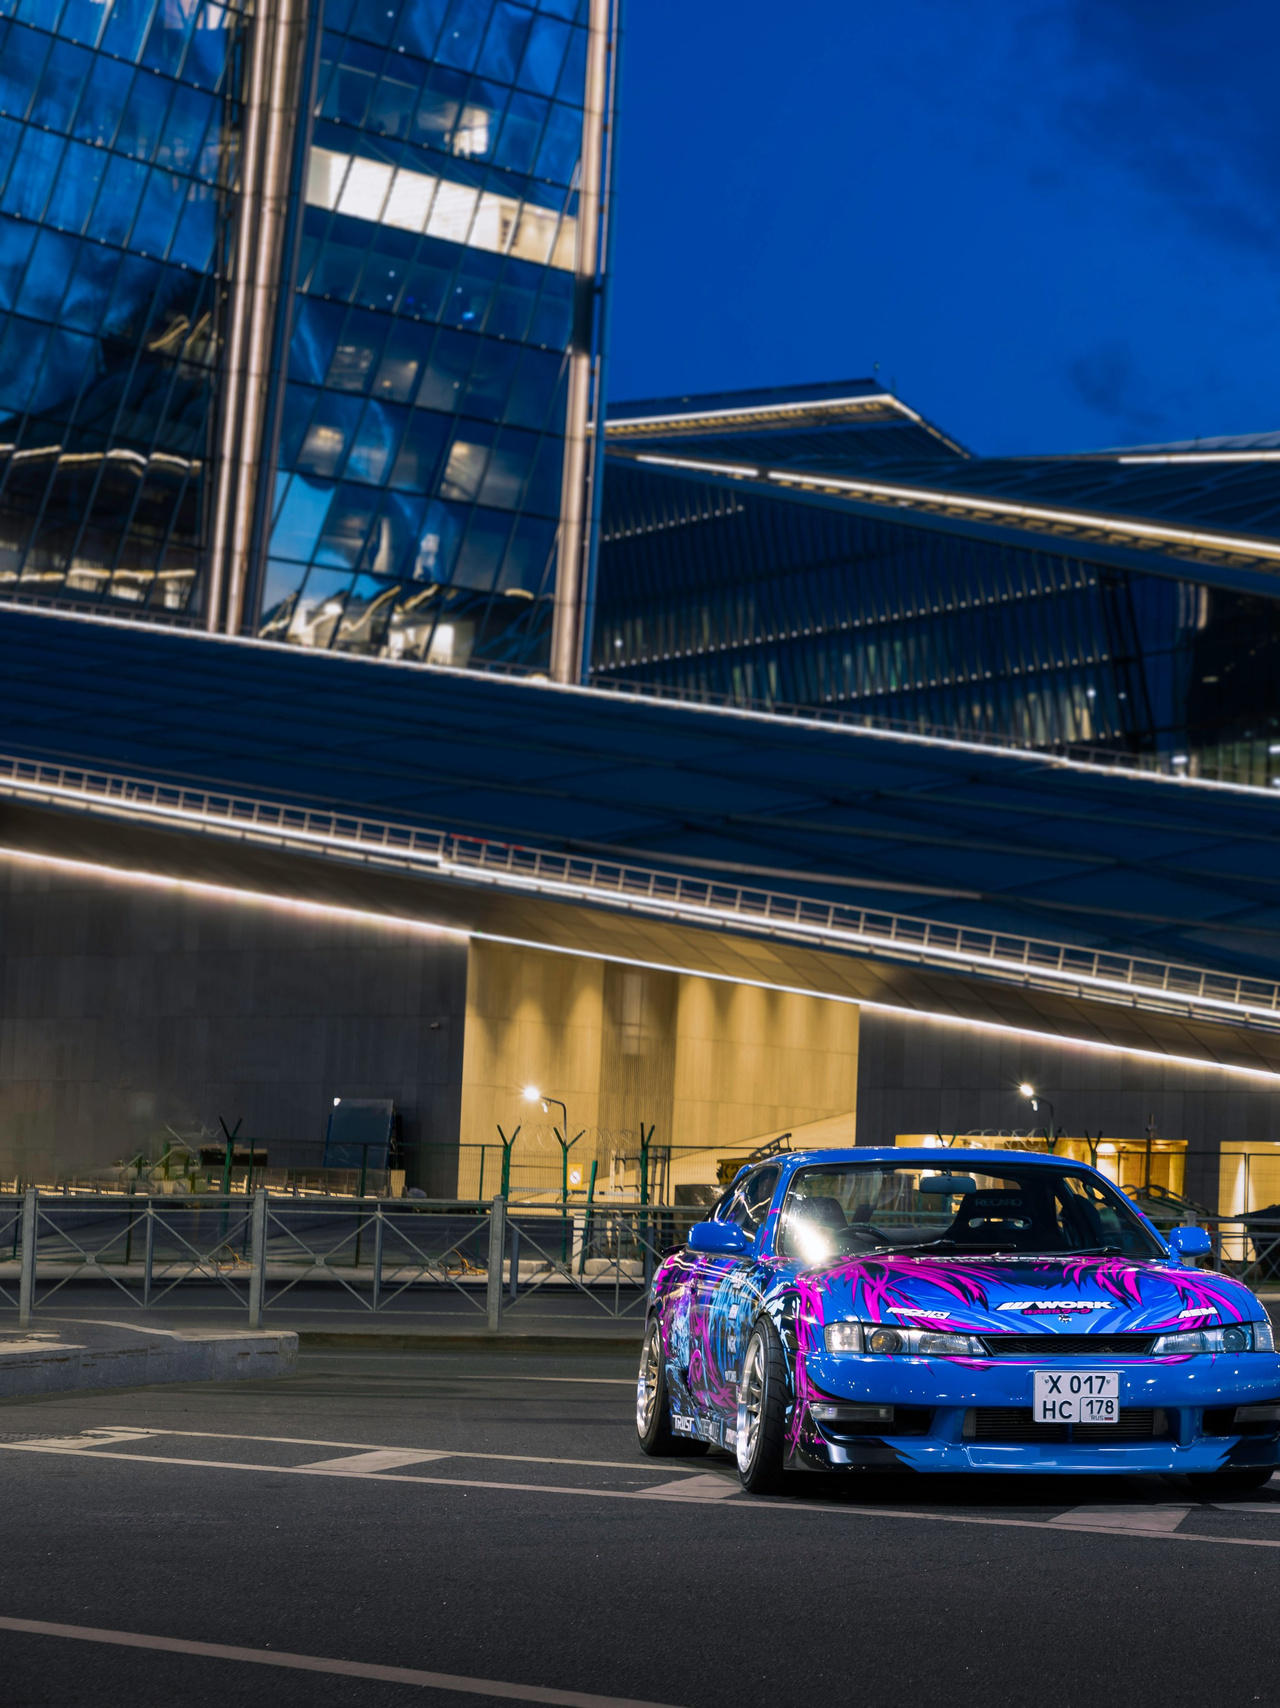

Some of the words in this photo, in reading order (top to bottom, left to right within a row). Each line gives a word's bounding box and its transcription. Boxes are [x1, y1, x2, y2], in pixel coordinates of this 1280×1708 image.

[975, 1198, 1023, 1207] RECARO
[1034, 1301, 1112, 1309] WORK
[1070, 1375, 1106, 1394] 017
[1085, 1400, 1114, 1415] 178
[672, 1414, 694, 1432] TRUST
